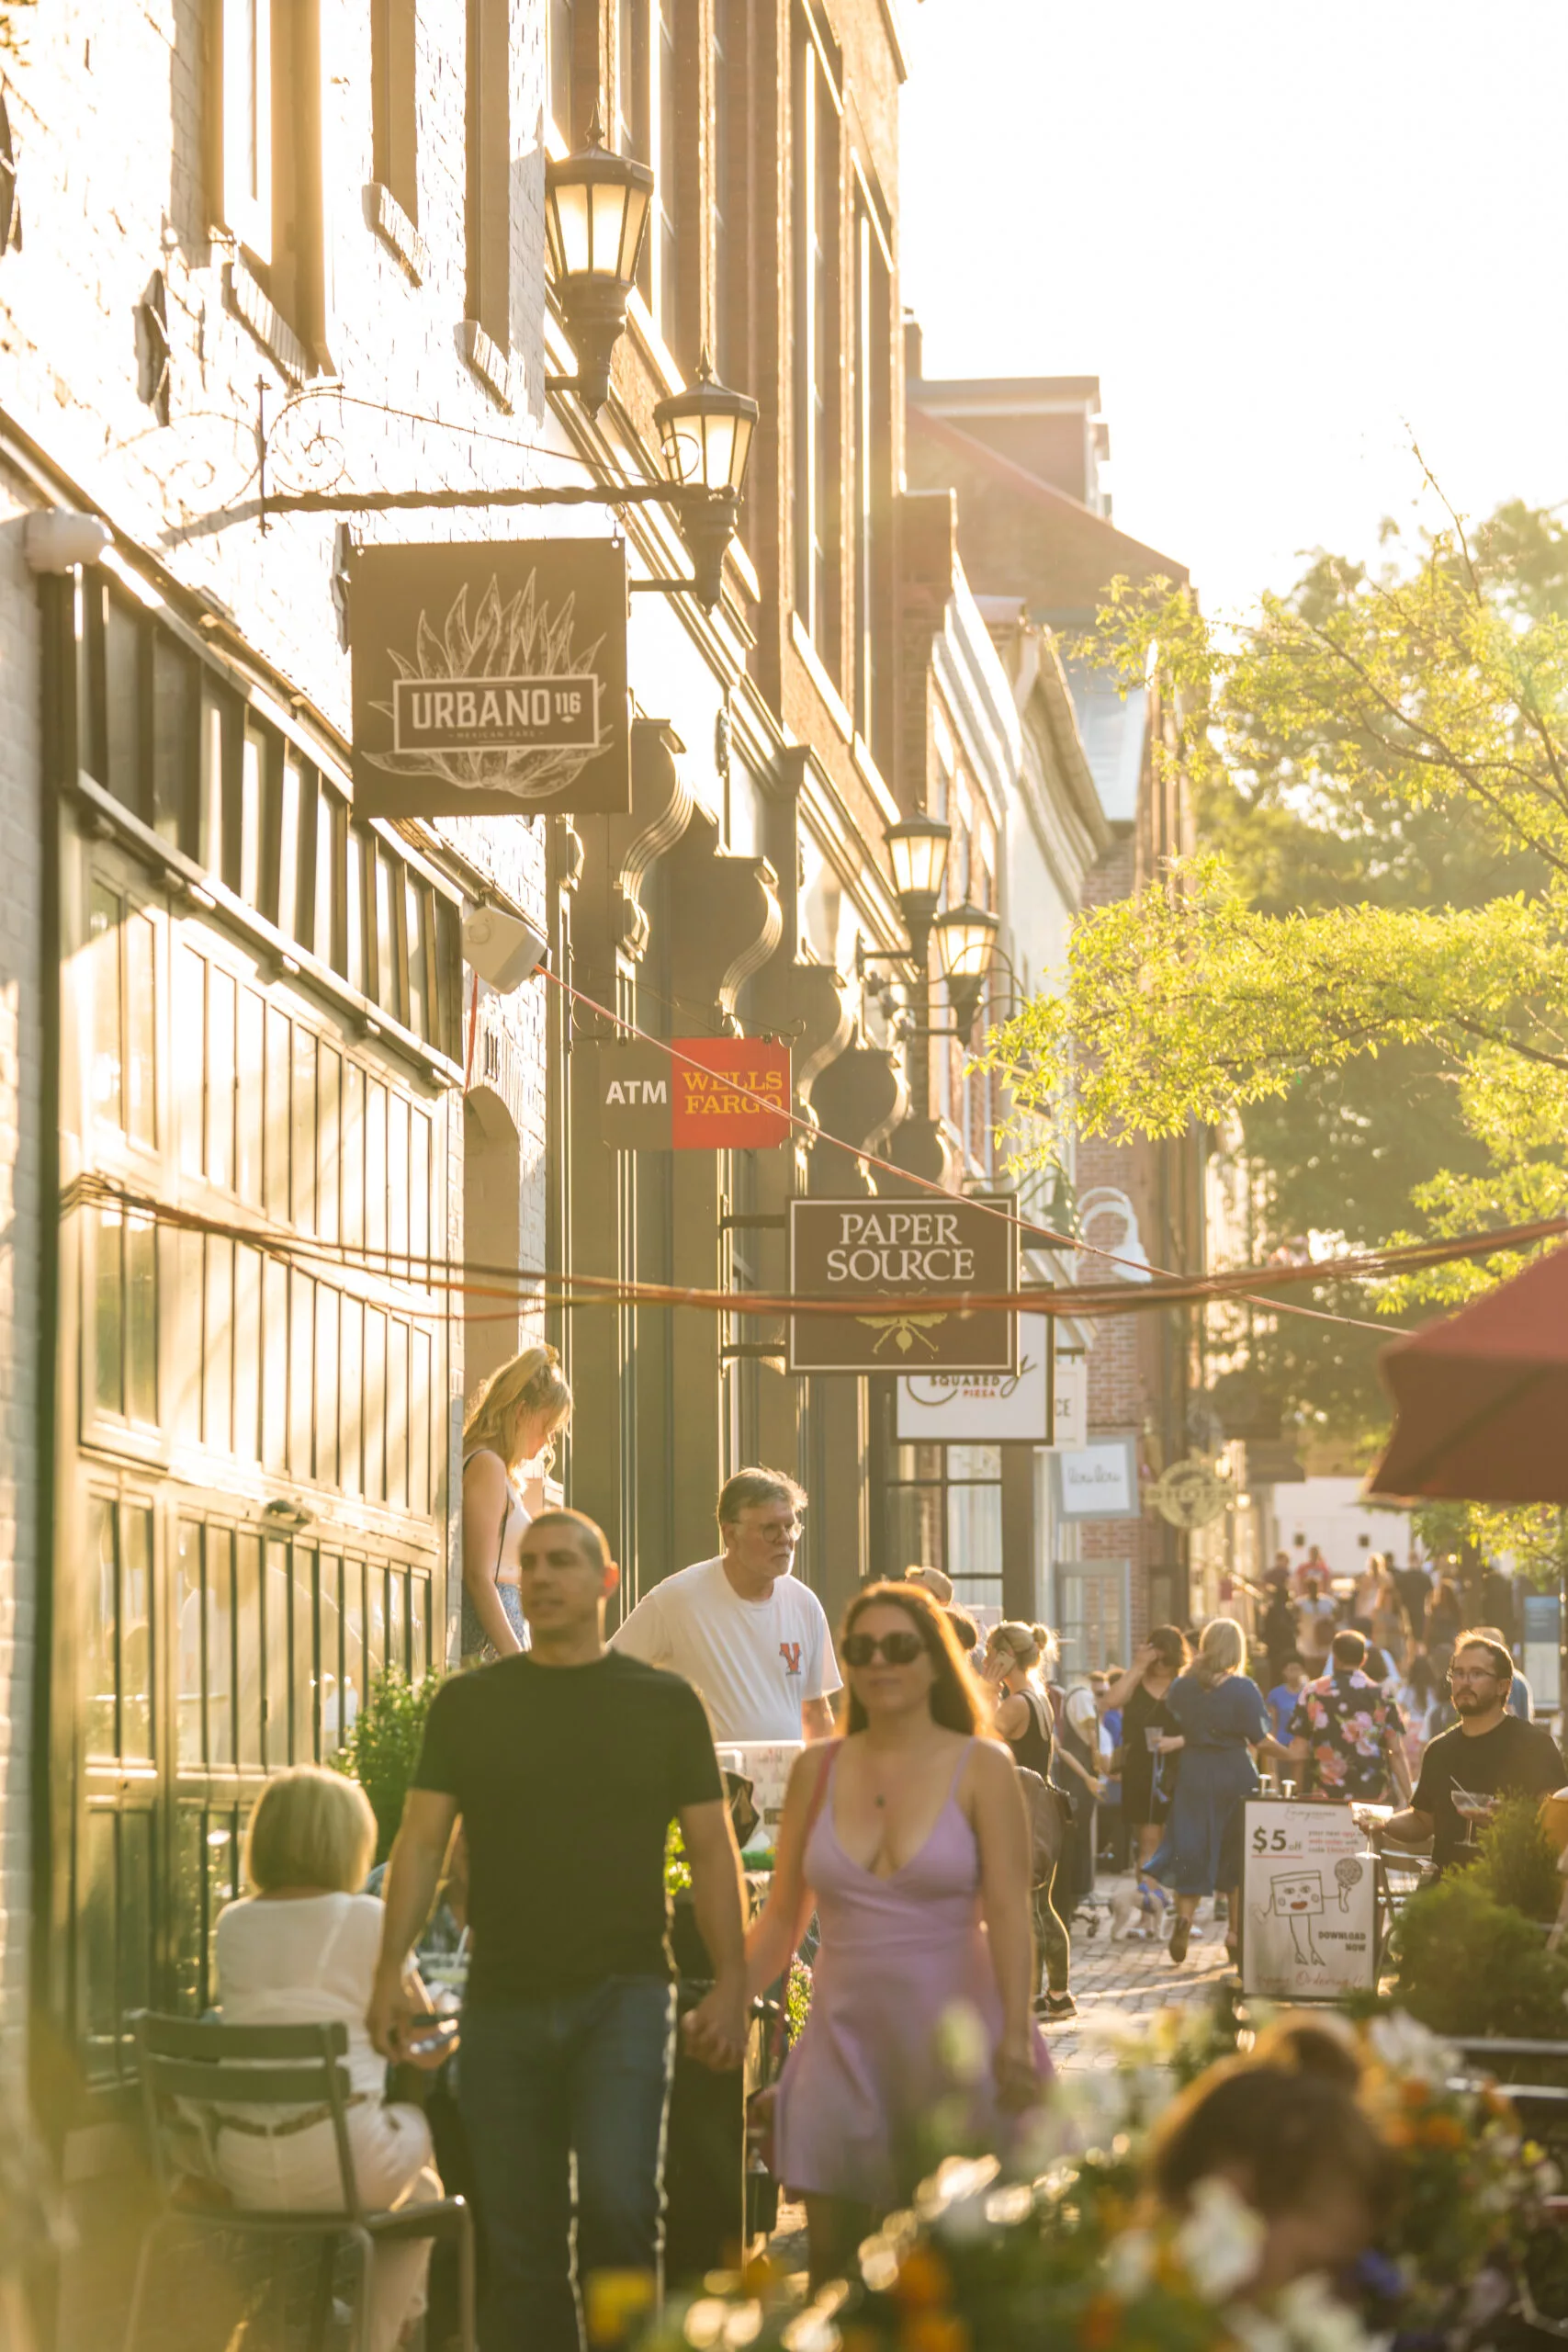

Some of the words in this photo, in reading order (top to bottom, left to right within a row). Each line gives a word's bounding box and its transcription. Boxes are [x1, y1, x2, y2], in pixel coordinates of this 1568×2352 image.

[412, 689, 550, 729] URBANO
[555, 692, 581, 715] 116
[605, 1080, 668, 1105] ATM
[682, 1070, 783, 1092] WELLS
[684, 1093, 783, 1115] FARGO
[840, 1214, 963, 1246] PAPER
[827, 1249, 976, 1282] SOURCE
[930, 1374, 1000, 1387] SQUARED
[1252, 1826, 1287, 1854] $5
[1288, 1840, 1303, 1851] off
[1318, 1930, 1367, 1941] DOWNLOAD
[1345, 1942, 1367, 1952] NOW
